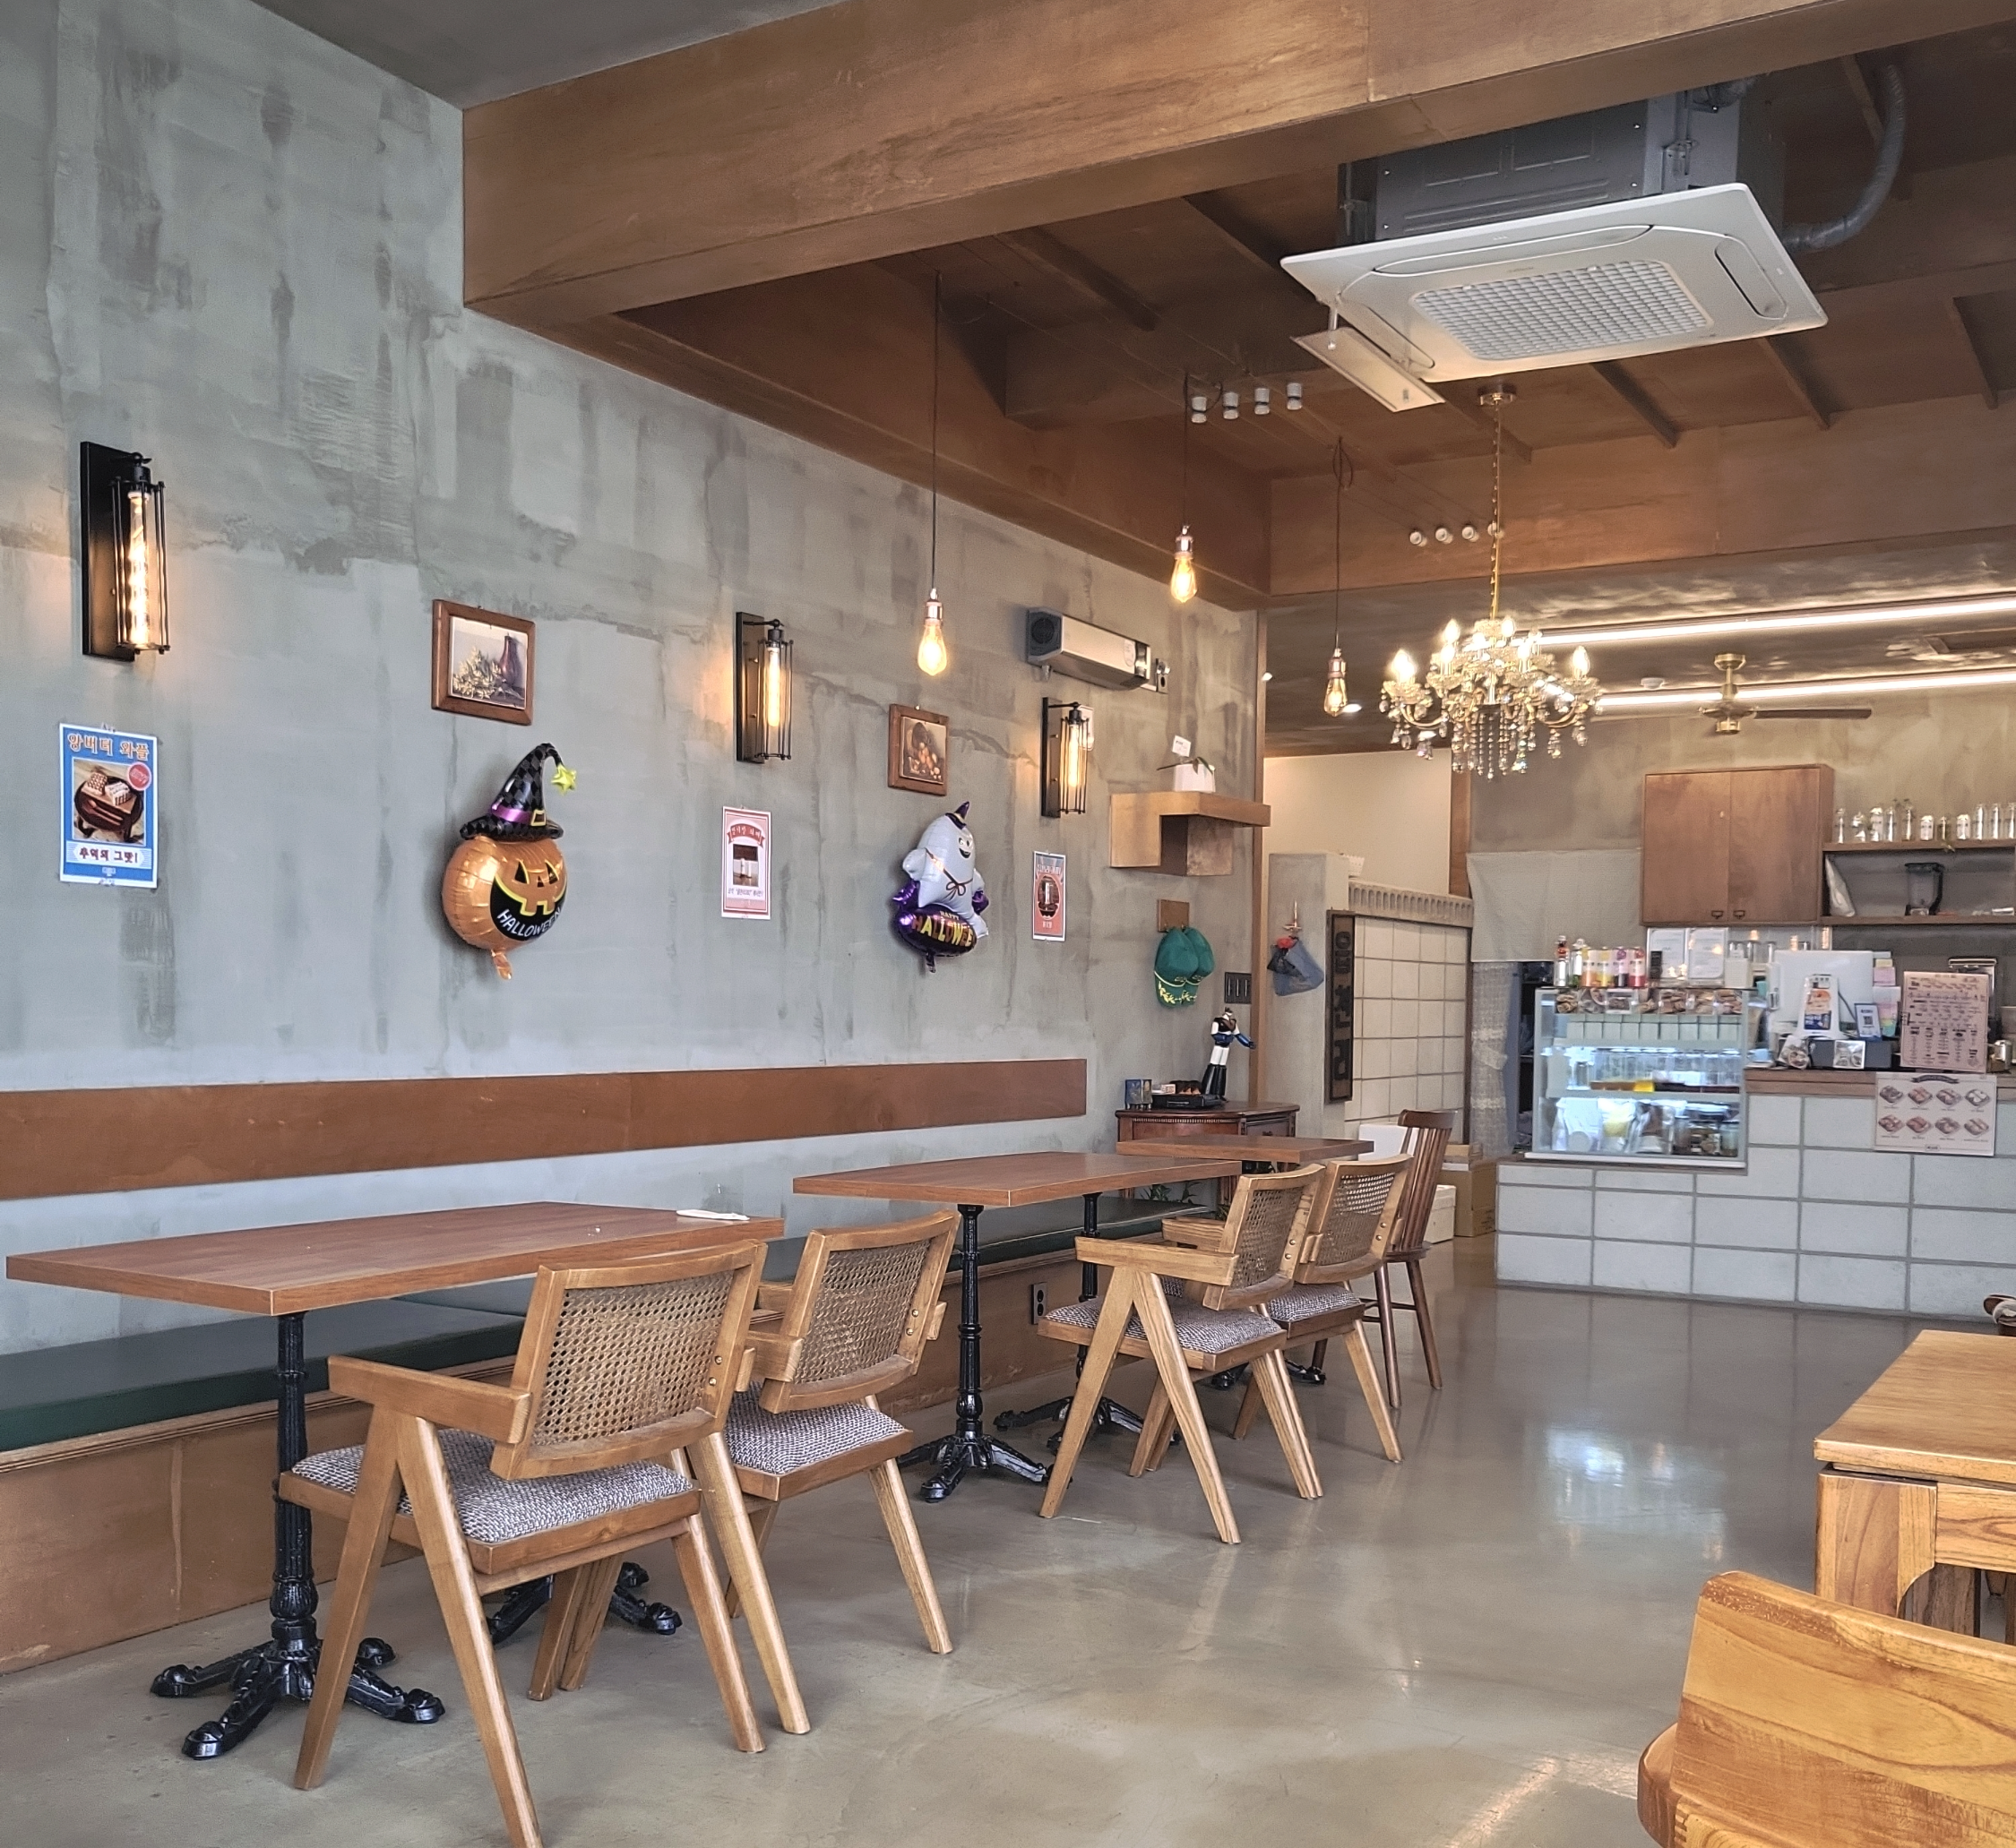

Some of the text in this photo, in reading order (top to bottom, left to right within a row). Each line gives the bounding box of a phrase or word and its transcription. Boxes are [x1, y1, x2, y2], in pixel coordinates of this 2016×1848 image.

[67, 733, 150, 761] 앙버터 와플
[79, 847, 109, 862] 추억의
[496, 906, 562, 937] HALLOWEEN
